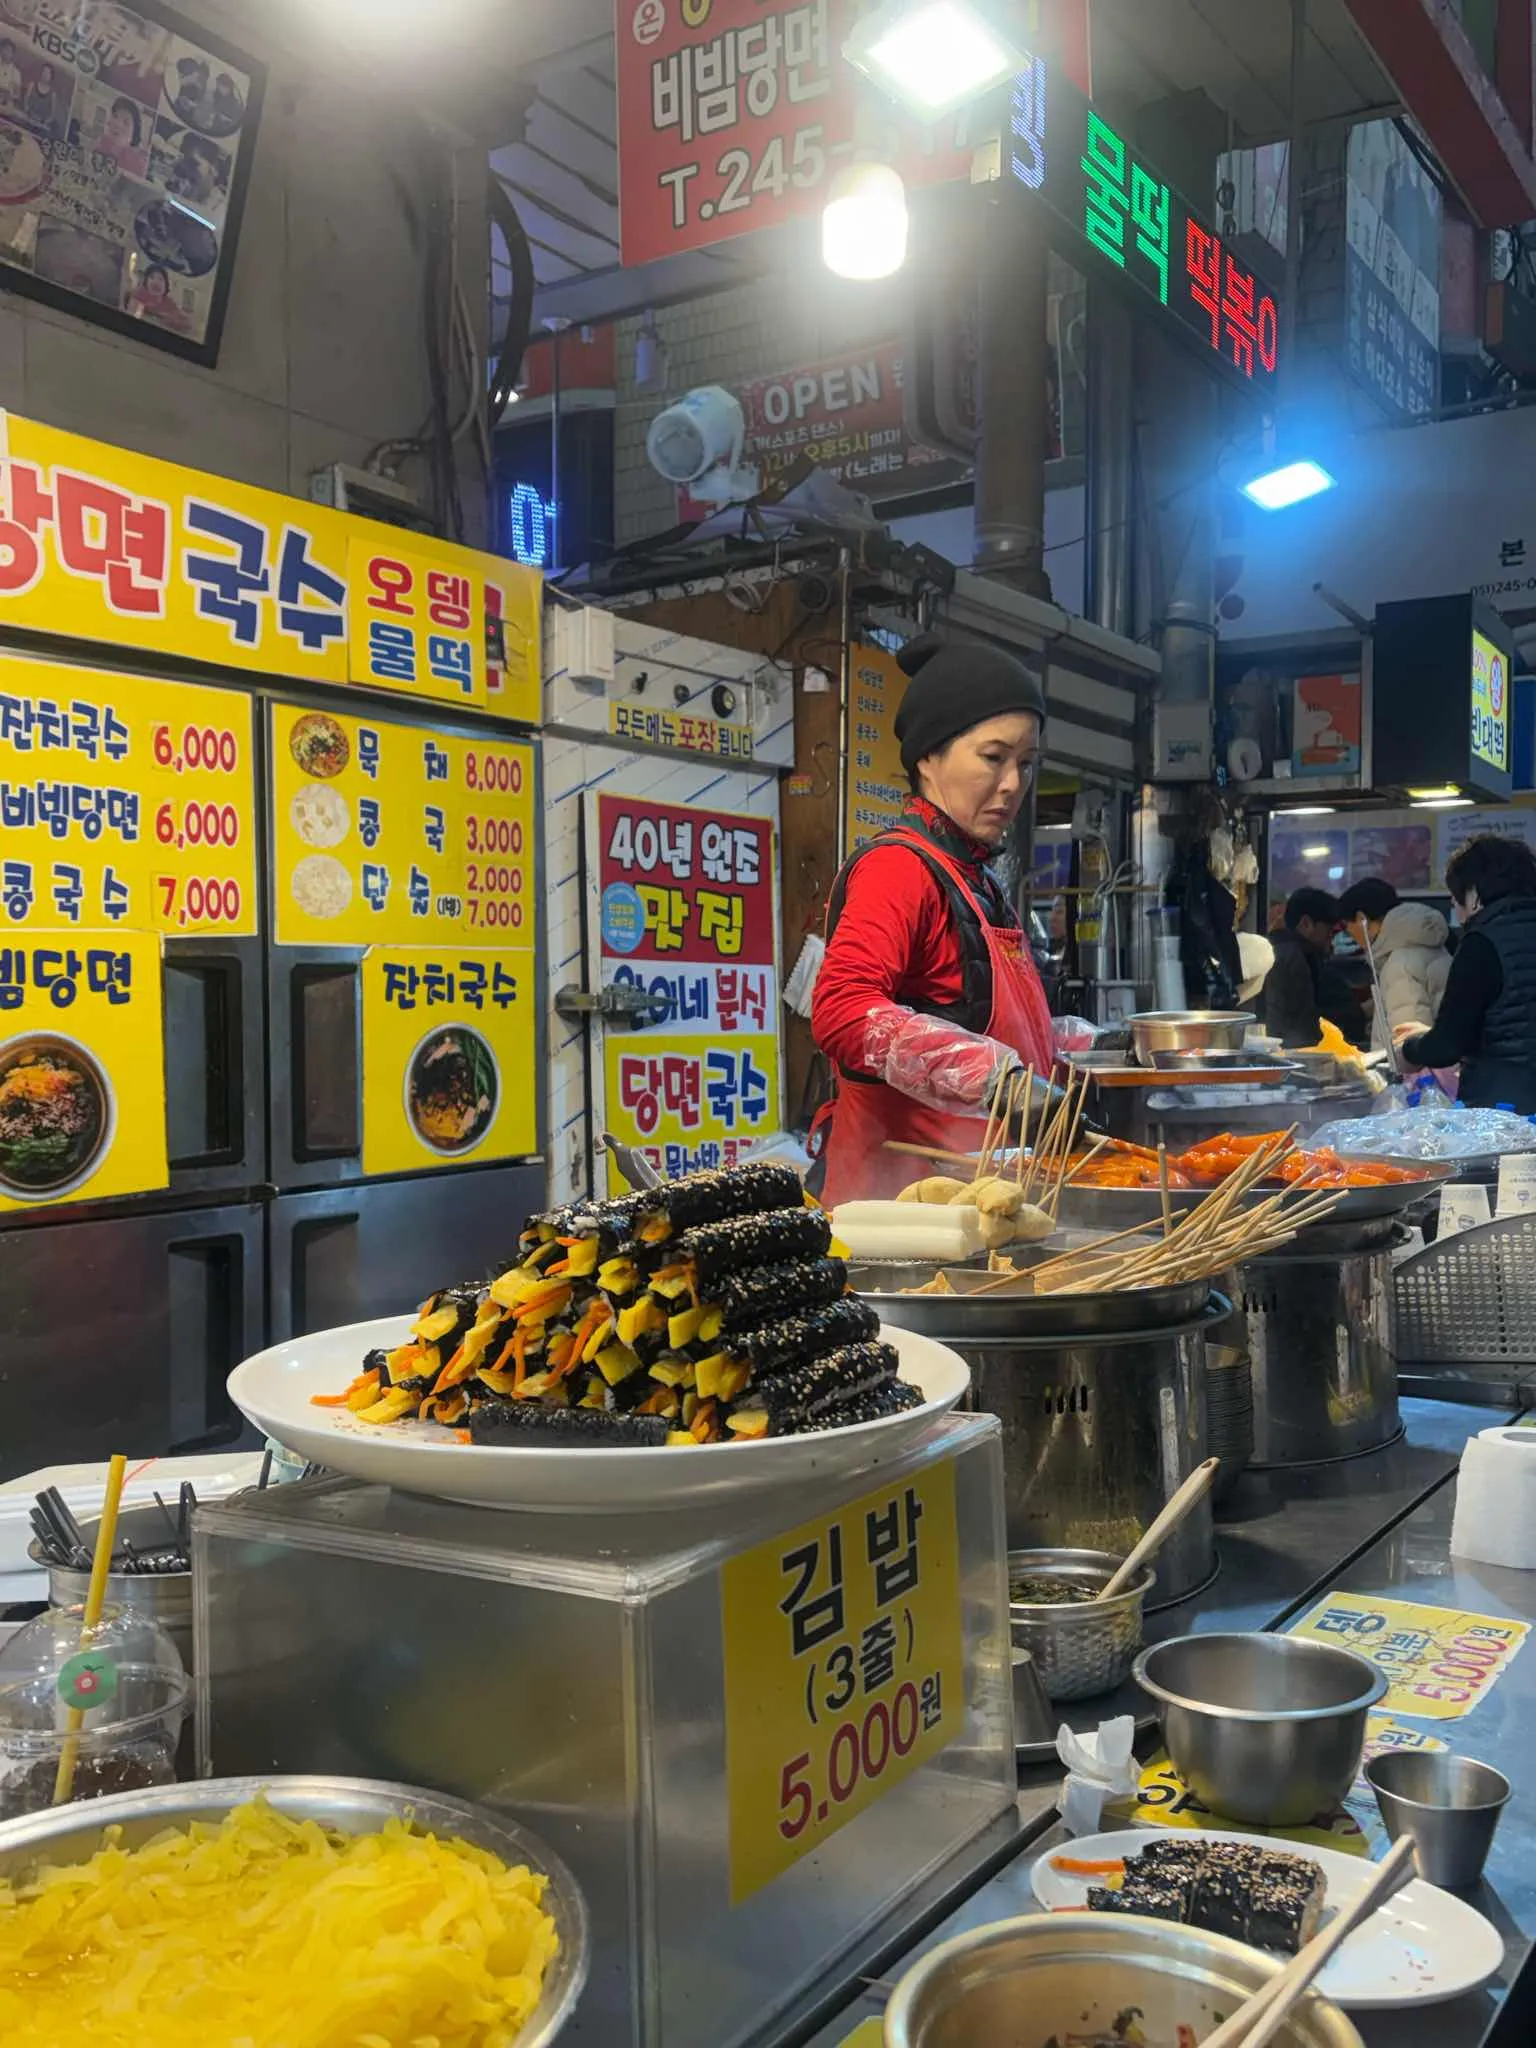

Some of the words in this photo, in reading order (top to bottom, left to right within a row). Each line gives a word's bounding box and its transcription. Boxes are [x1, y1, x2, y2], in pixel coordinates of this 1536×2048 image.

[652, 0, 832, 138] 비빔당면
[1081, 110, 1170, 306] 물떡
[763, 356, 881, 425] OPEN
[0, 693, 129, 760] 잔치국수
[154, 726, 237, 773] 6,000
[0, 781, 139, 840] 비빔당면
[156, 803, 239, 849] 6,000
[608, 815, 693, 880] 40년
[701, 821, 760, 884] 원조
[158, 876, 241, 925] 7,000
[383, 960, 517, 1010] 잔치국수
[715, 967, 767, 1031] 분식
[806, 1608, 914, 1724] (3줄)
